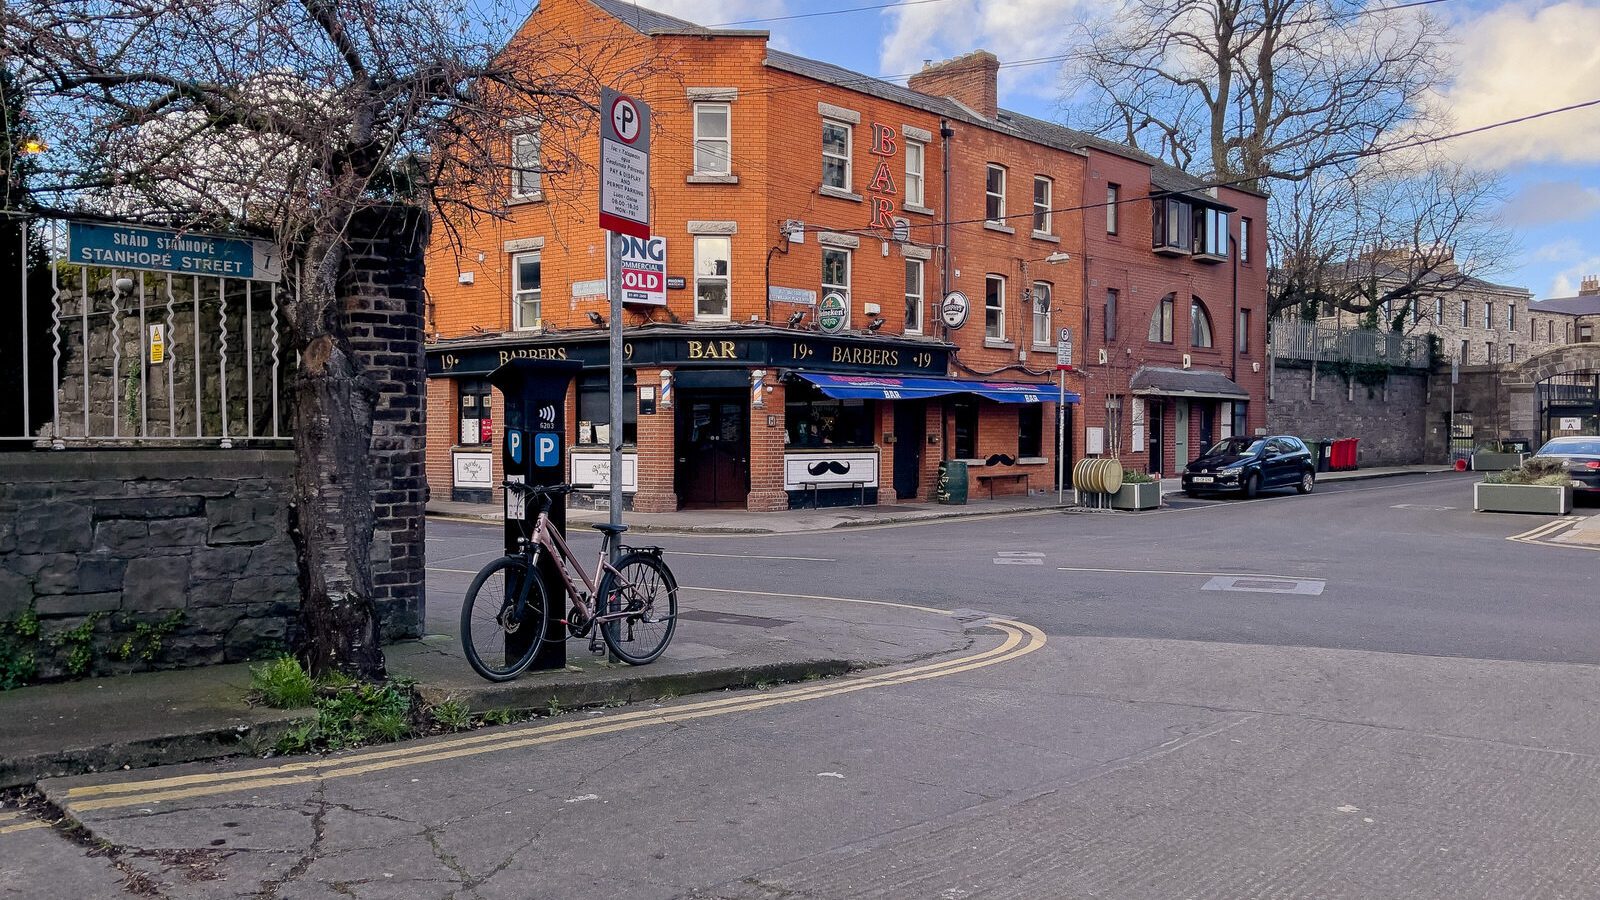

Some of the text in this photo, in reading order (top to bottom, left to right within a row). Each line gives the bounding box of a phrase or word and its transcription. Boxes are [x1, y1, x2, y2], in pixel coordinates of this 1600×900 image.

[622, 105, 634, 133] P
[606, 180, 644, 196] PERMIT PARKING
[623, 172, 640, 182] DISPLAY
[868, 121, 898, 231] BAR
[114, 230, 214, 255] SRÁID STANHOPE
[82, 247, 172, 266] STANHOPE
[182, 257, 243, 273] STREET
[622, 261, 658, 270] OMMERCIAL
[688, 340, 738, 359] BAR
[792, 343, 932, 368] 19 BARBERS 19
[441, 354, 454, 370] 19
[884, 390, 902, 399] BAR
[512, 433, 520, 458] P
[540, 438, 554, 462] P
